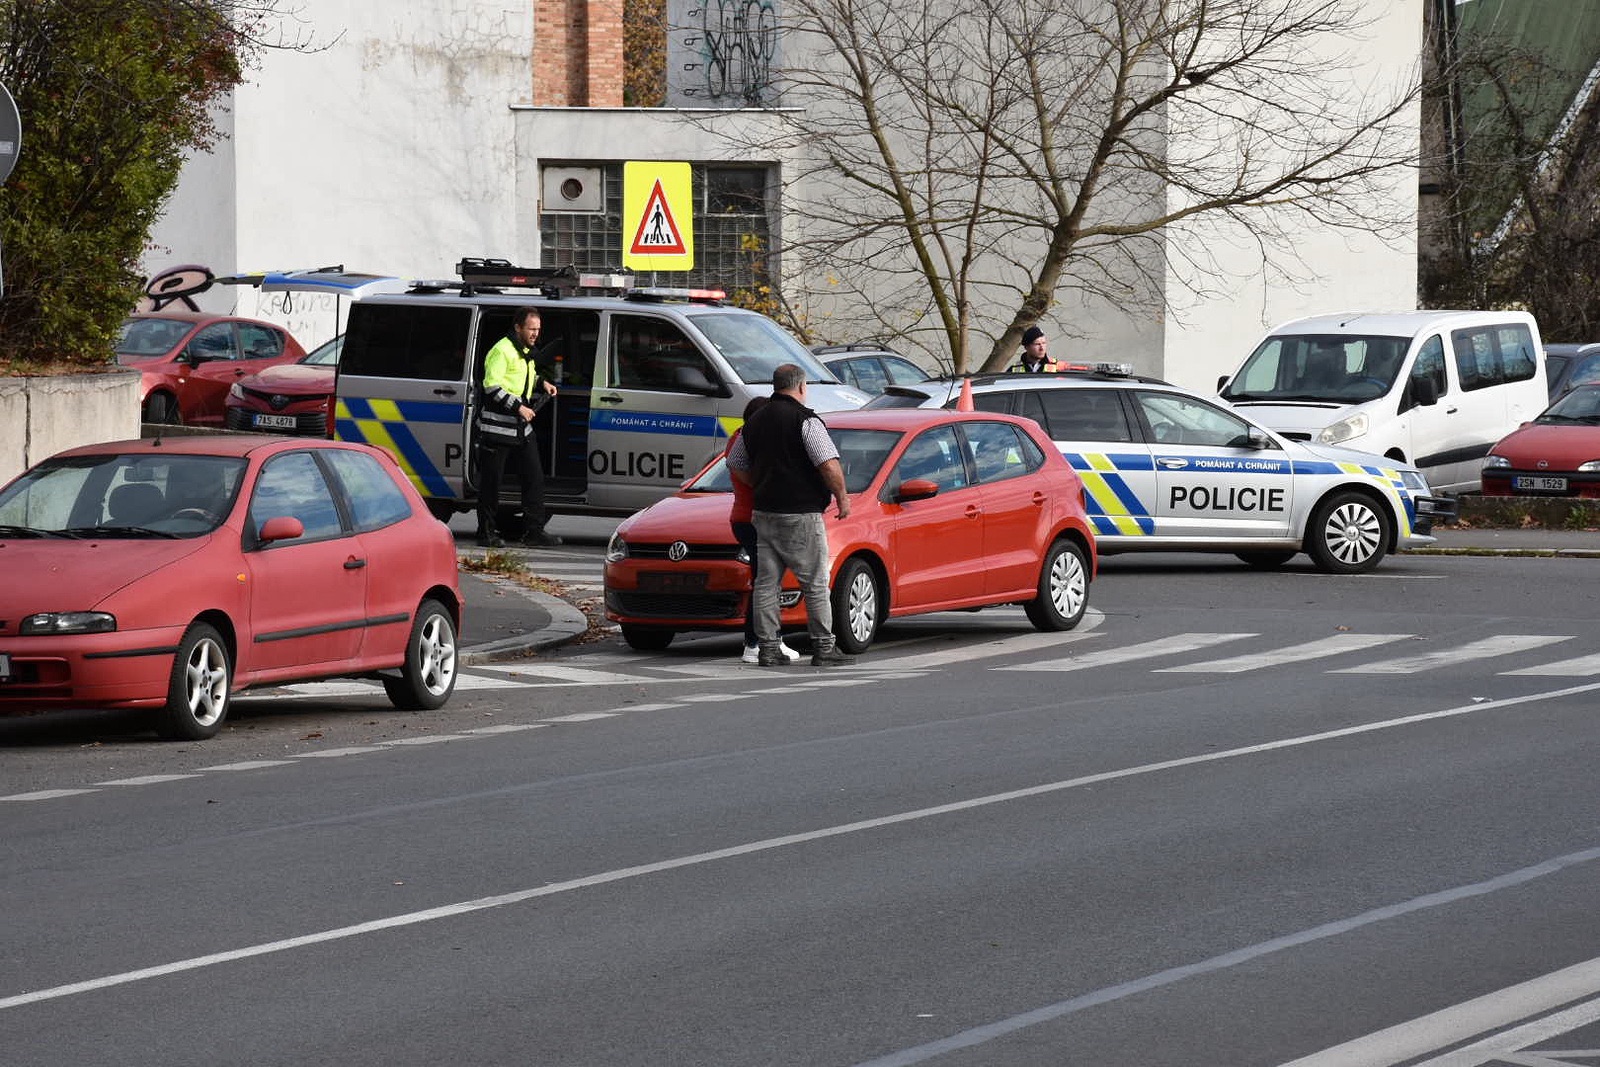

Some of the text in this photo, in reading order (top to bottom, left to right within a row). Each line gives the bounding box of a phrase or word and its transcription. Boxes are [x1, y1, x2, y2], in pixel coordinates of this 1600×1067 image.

[611, 417, 649, 427] POMÁHAT
[660, 420, 695, 430] CHRÁNIT
[1195, 459, 1281, 471] POMÁHAT A CHRÁNIT
[1169, 486, 1285, 512] POLICIE
